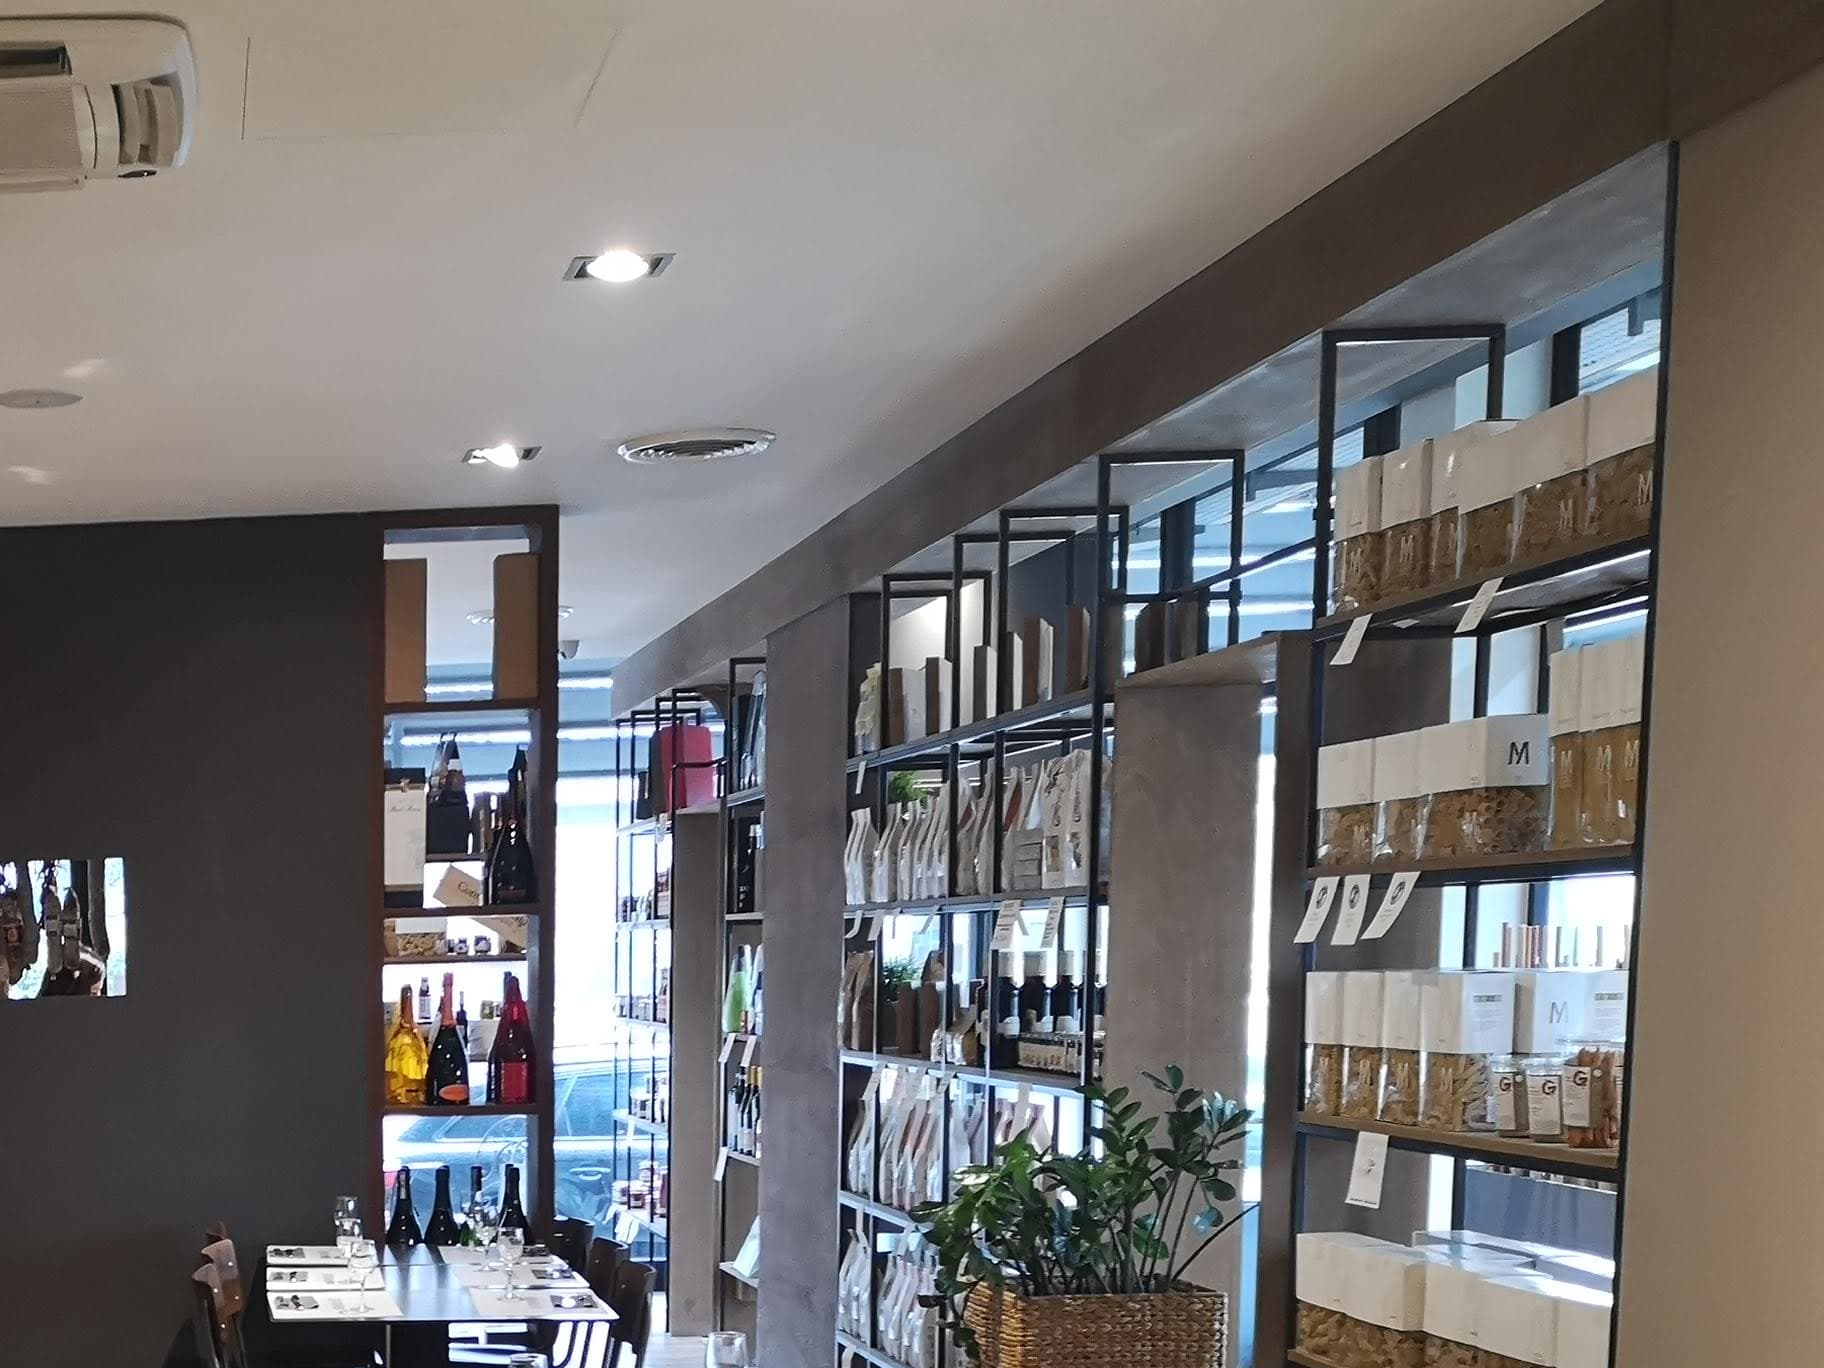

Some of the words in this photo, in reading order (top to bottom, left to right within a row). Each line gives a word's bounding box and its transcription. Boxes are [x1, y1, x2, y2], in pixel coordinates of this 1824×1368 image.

[1507, 741, 1530, 765] M
[1550, 1001, 1569, 1024] M
[1499, 1077, 1512, 1092] G
[1541, 1079, 1557, 1095] G
[1572, 1070, 1589, 1087] G
